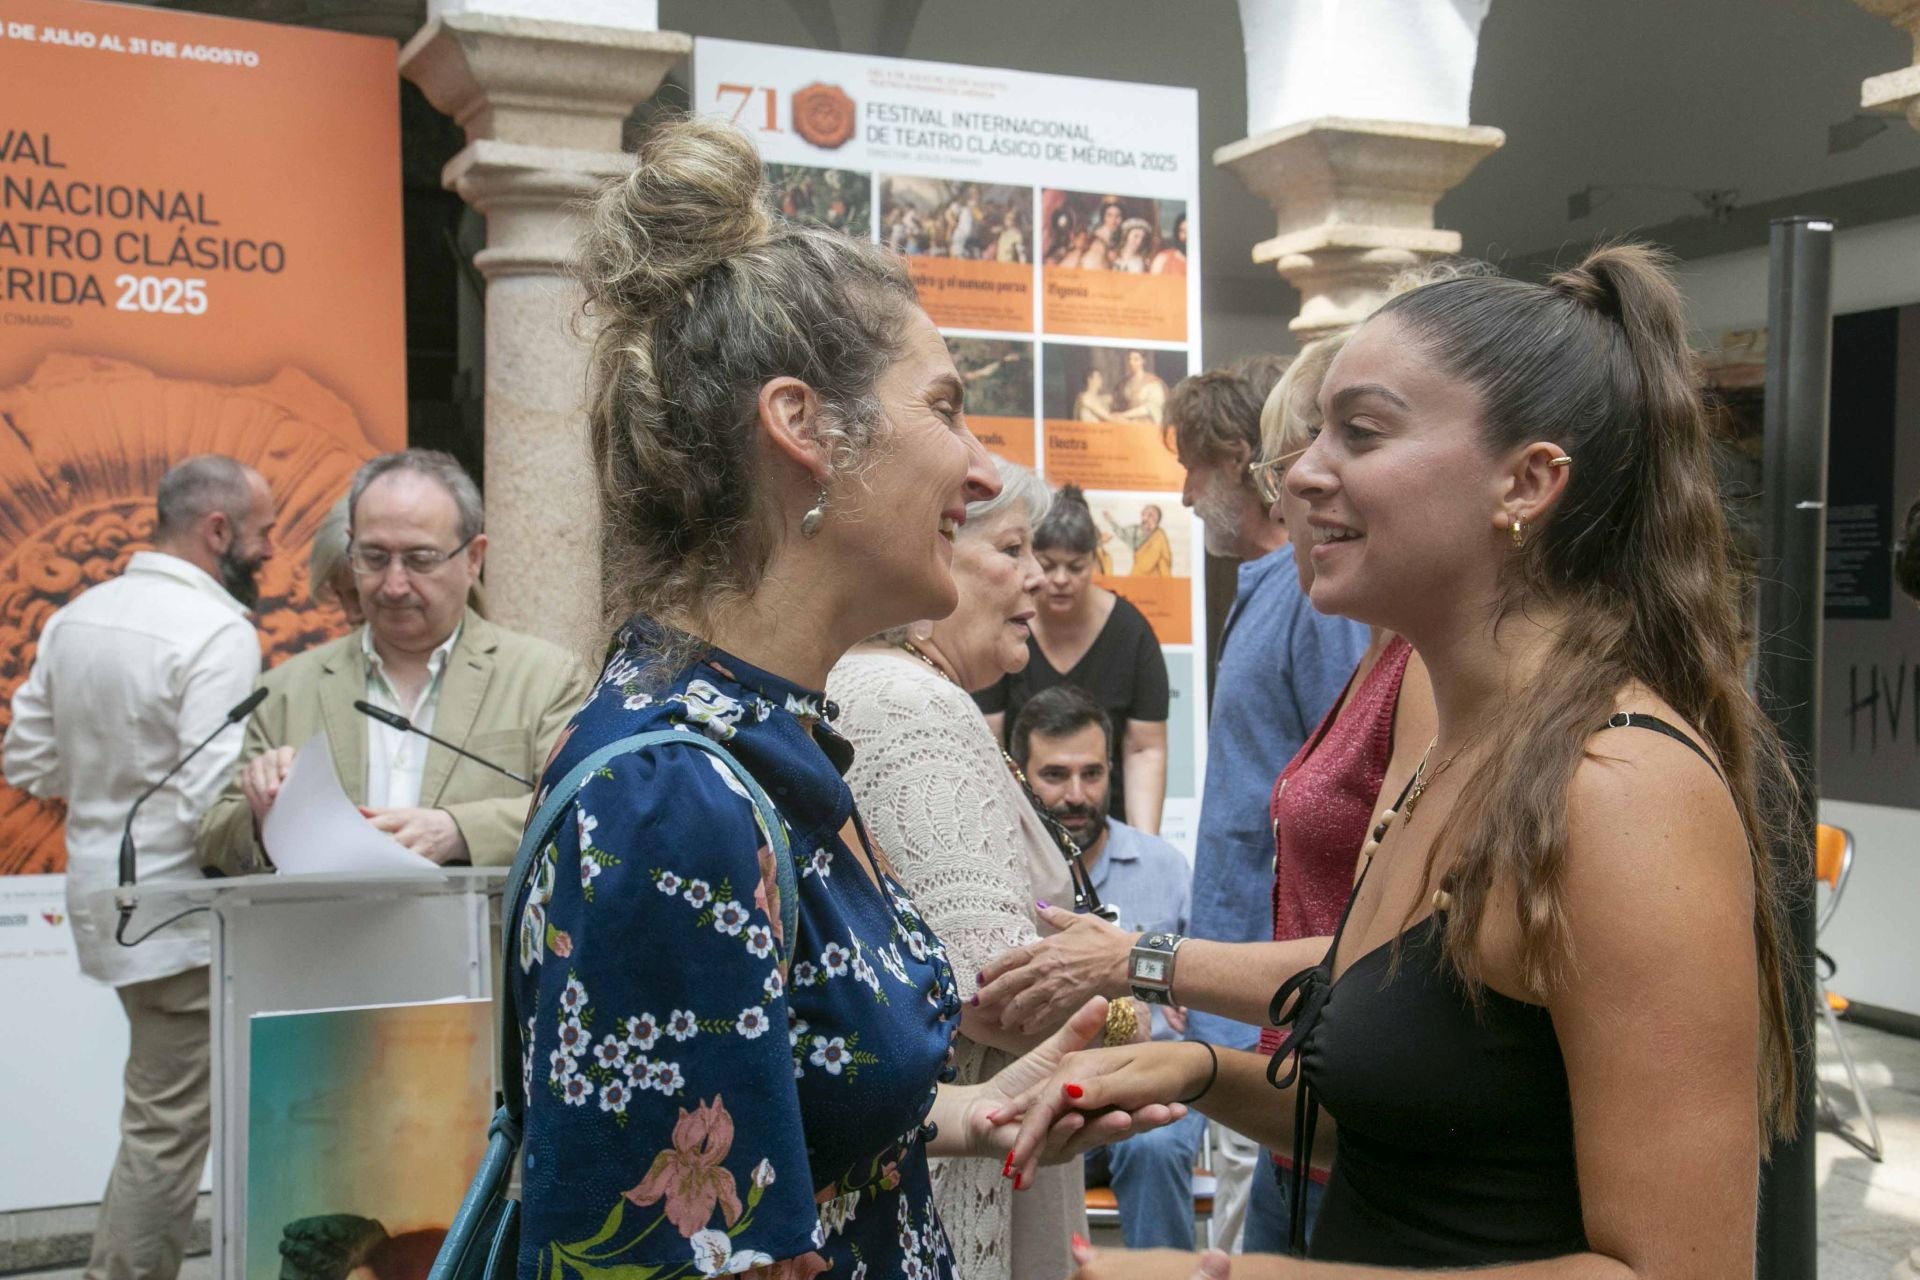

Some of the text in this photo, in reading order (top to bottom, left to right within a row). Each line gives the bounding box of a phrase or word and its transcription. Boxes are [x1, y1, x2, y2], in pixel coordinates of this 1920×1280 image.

[8, 22, 35, 41] DE
[40, 27, 96, 48] JULIO
[99, 34, 125, 52] AL
[129, 37, 147, 54] 31
[151, 40, 176, 58] DE
[181, 44, 259, 67] AGOSTO
[716, 84, 784, 133] 71
[866, 102, 1094, 143] FESTIVAL INTERNACIONAL
[866, 125, 889, 145] DE
[895, 127, 963, 151] TEATRO
[967, 133, 1041, 157] CLÁSICO
[1045, 142, 1067, 162] DE
[1072, 145, 1136, 167] MÉRIDA
[1141, 152, 1178, 171] 2025
[4, 174, 219, 226] NACIONAL
[115, 225, 285, 273] CLÁSICO
[115, 275, 208, 314] 2025
